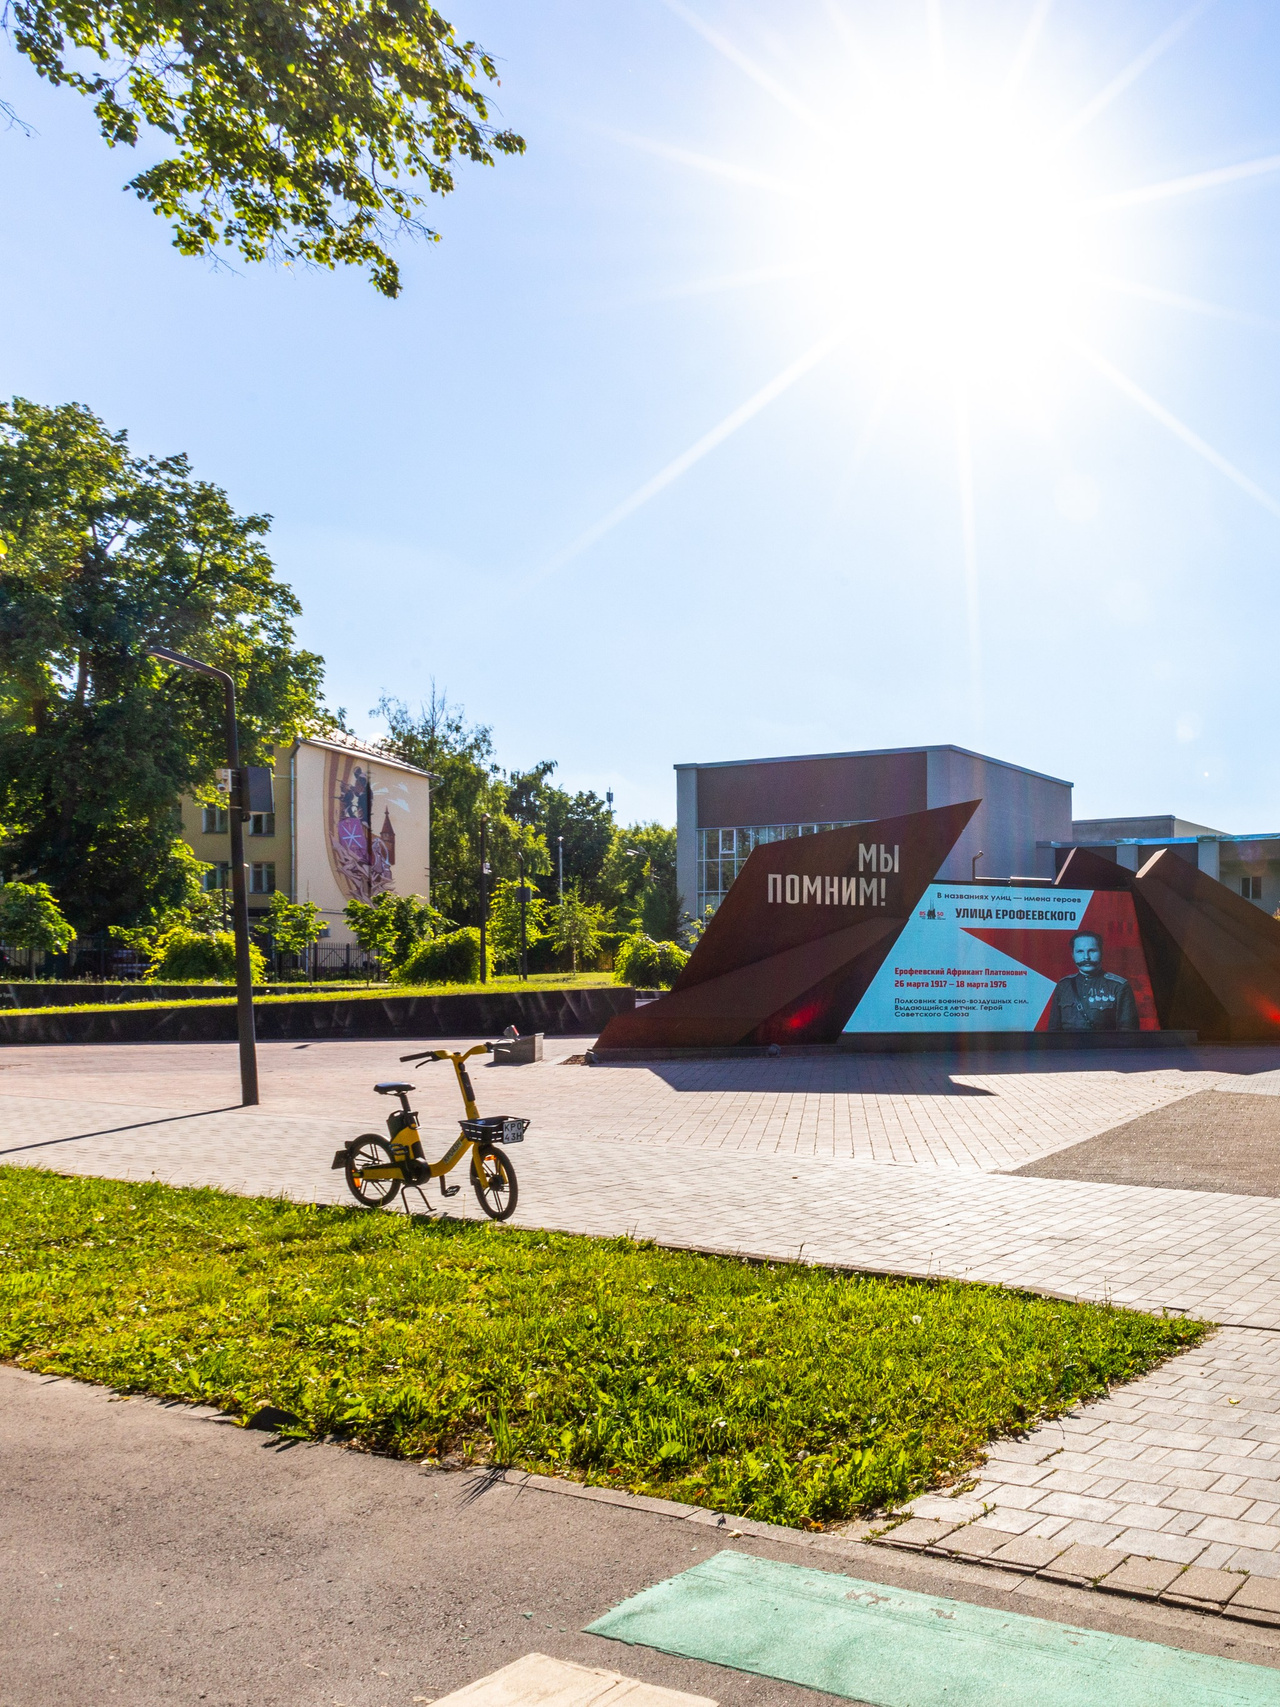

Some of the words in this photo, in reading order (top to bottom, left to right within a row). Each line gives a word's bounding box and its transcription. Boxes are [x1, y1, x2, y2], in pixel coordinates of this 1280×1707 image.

[858, 843, 899, 873] МЫ
[768, 874, 886, 906] ПОМНИМ!
[956, 908, 992, 920] УЛИЦА
[995, 909, 1076, 921] ЕРОФЕЕВСКОГО
[895, 968, 944, 976] Ерофеевский
[947, 968, 983, 976] Африкант
[985, 968, 1027, 976] Платонович
